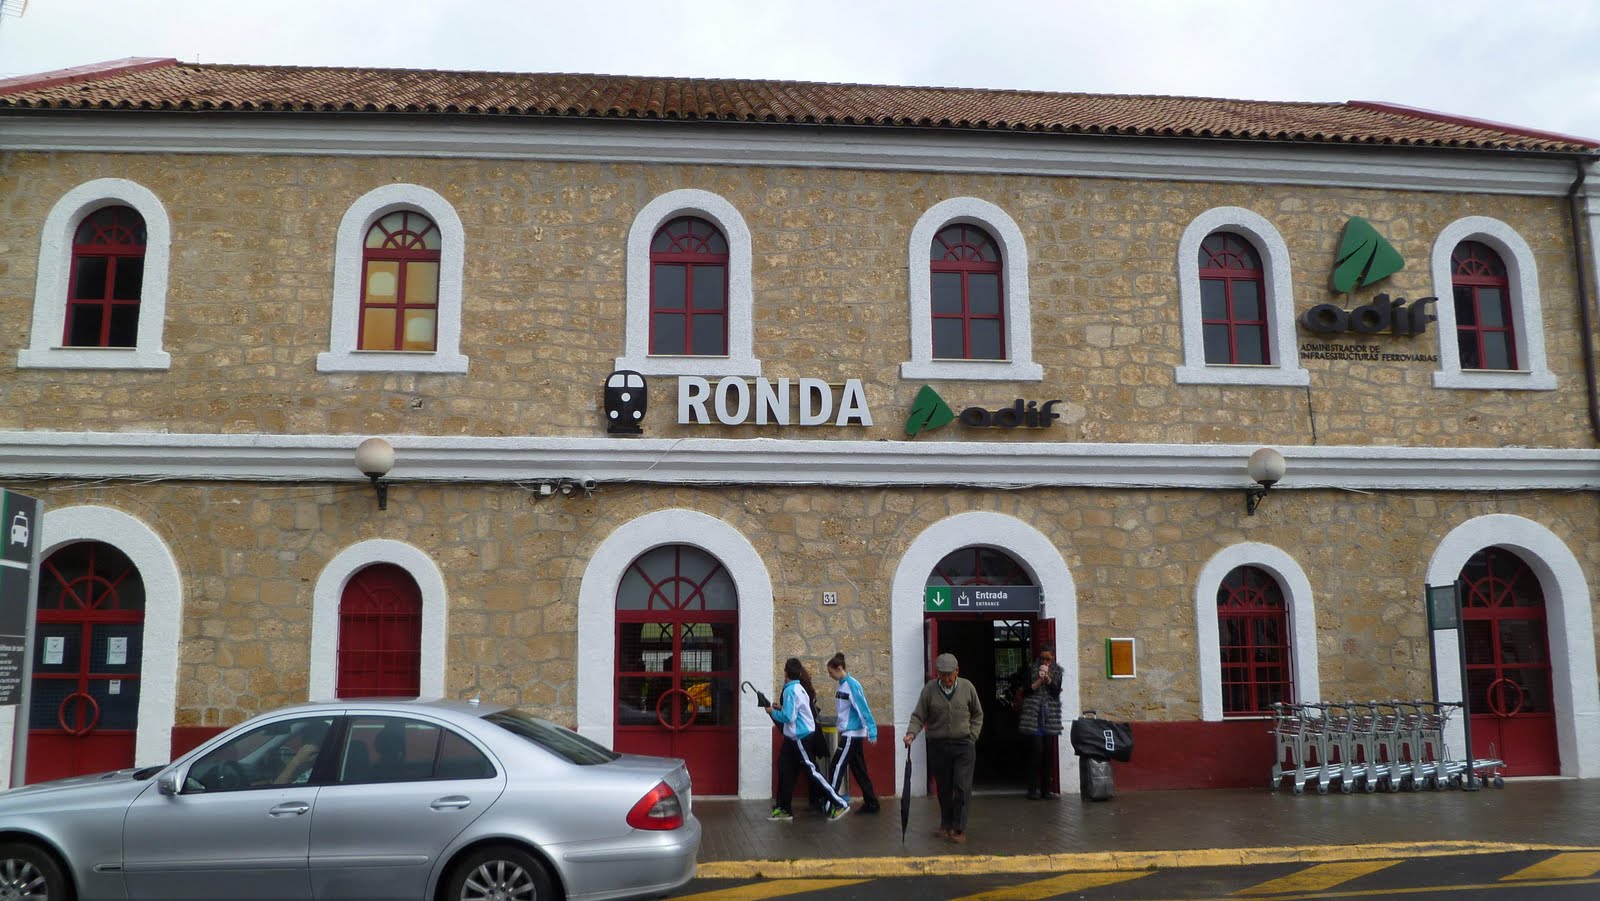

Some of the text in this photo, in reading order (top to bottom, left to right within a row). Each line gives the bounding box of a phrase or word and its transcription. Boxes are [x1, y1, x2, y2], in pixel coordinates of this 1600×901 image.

[1298, 293, 1439, 337] adif
[1301, 343, 1380, 353] ADMINISTRADOR DE
[1301, 352, 1437, 362] INFRAESTRUCTURAS FERROVIARIAS
[678, 376, 874, 427] RONDA
[960, 398, 1062, 428] adif
[824, 594, 836, 603] 31
[975, 591, 1008, 599] Entrada
